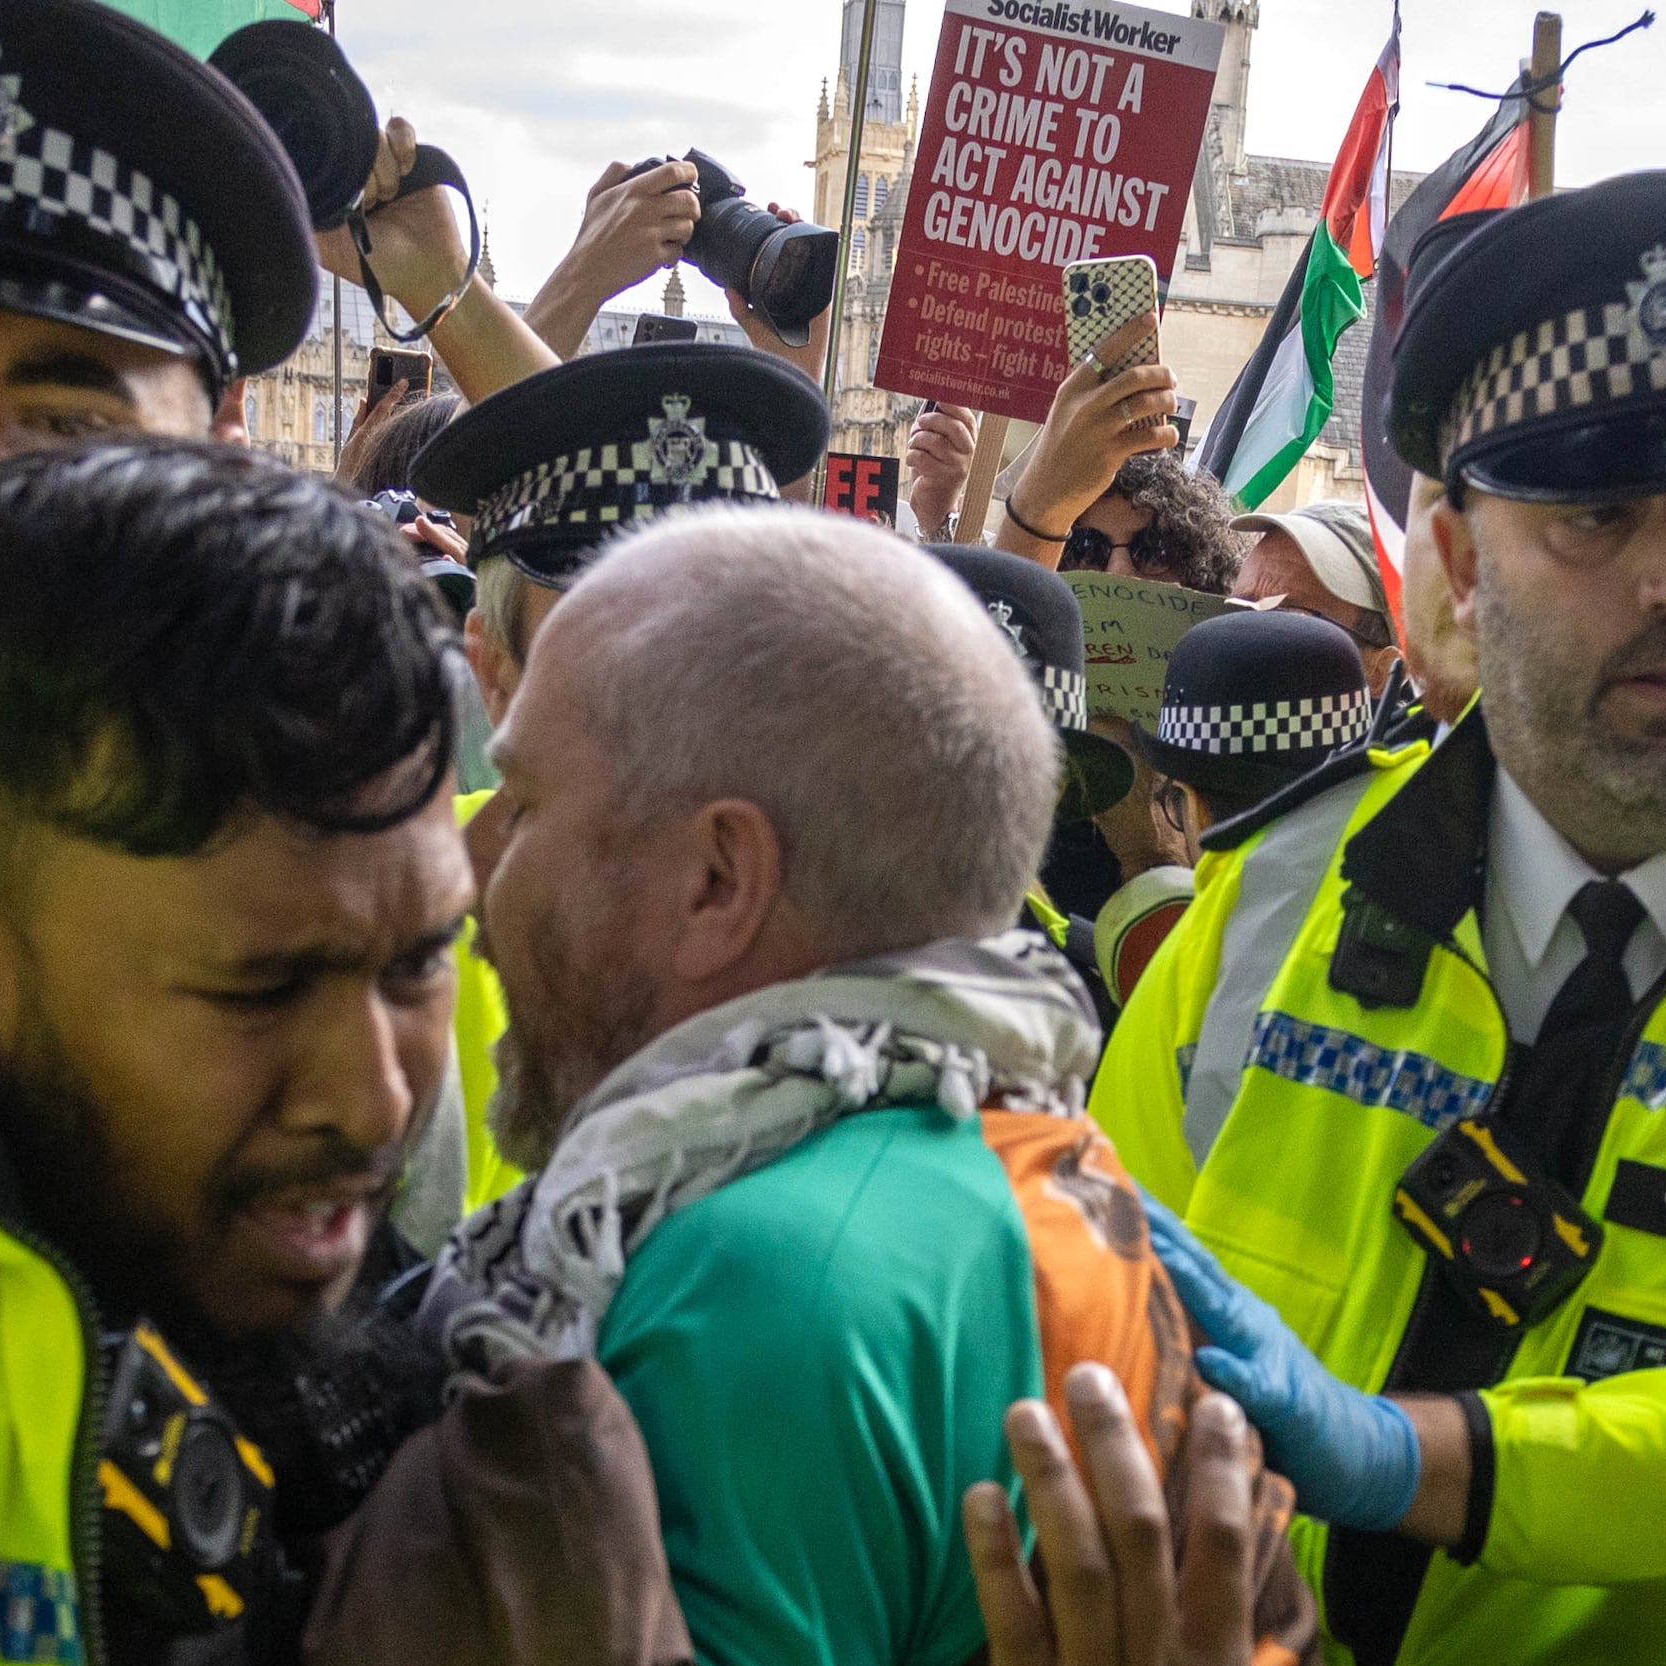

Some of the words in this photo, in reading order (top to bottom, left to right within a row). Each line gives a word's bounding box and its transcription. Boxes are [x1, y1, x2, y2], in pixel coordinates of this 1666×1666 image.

[987, 0, 1092, 36] Socialist
[1093, 10, 1181, 54] Worker
[954, 24, 1027, 87] IT'S
[1034, 44, 1115, 105] NOT
[1117, 62, 1145, 114] A
[945, 81, 1064, 152] CRIME
[1074, 107, 1121, 164] TO
[930, 136, 1007, 196] ACT
[1010, 154, 1170, 232] AGAINST
[923, 191, 1106, 268] GENOCIDE
[927, 261, 970, 294] Free
[975, 272, 1065, 314] Palestine
[920, 294, 990, 332] Defend
[991, 315, 1065, 348] protest
[915, 329, 972, 362] rights
[991, 344, 1039, 378] fight
[908, 368, 1011, 400] socialistworker.co.uk
[1072, 584, 1205, 615] ENOCIDE
